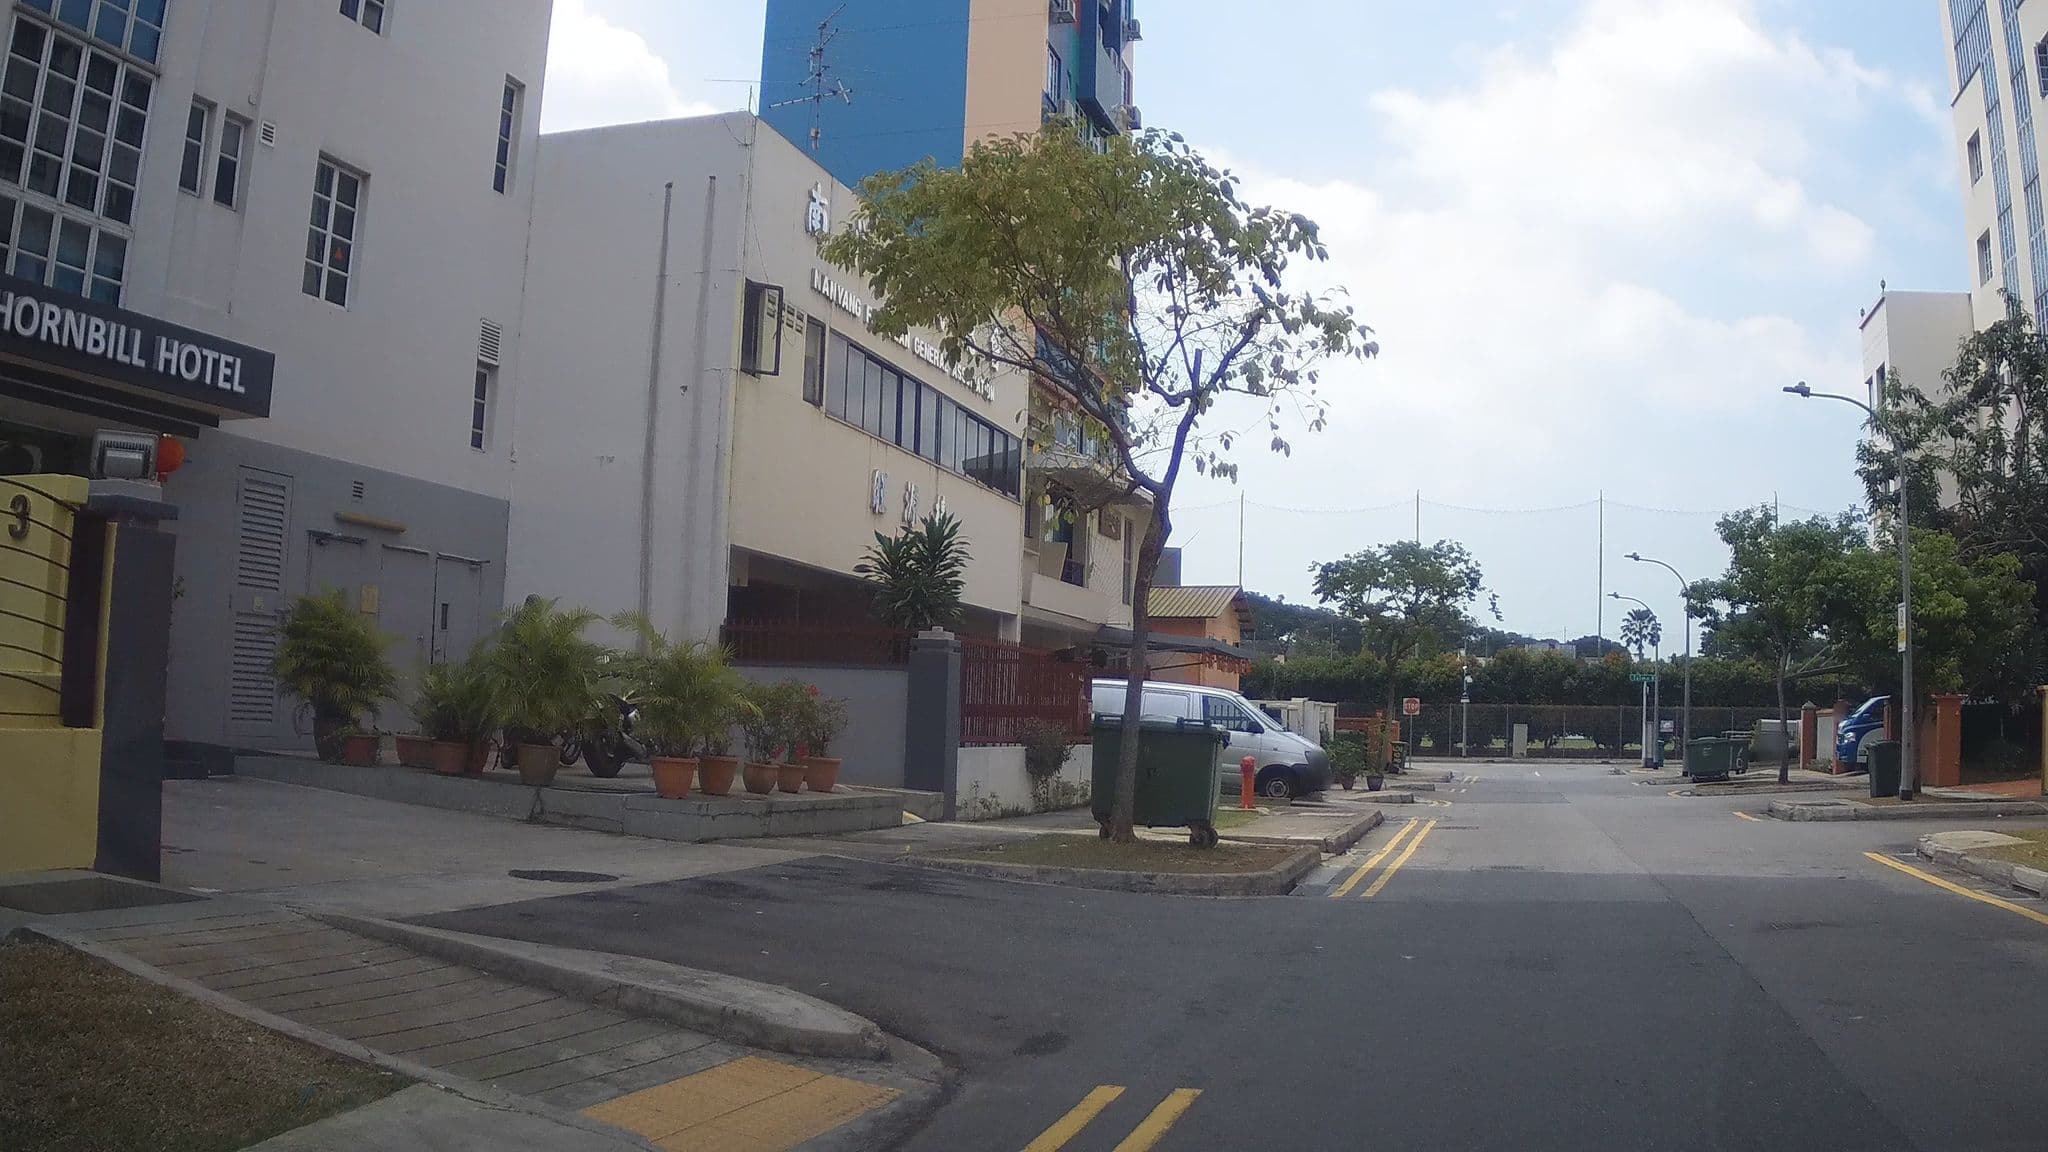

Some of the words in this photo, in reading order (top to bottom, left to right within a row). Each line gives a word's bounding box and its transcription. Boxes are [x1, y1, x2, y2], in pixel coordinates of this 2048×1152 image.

[812, 268, 862, 317] NANYANG
[156, 335, 245, 394] HOTEL
[8, 494, 32, 539] 3
